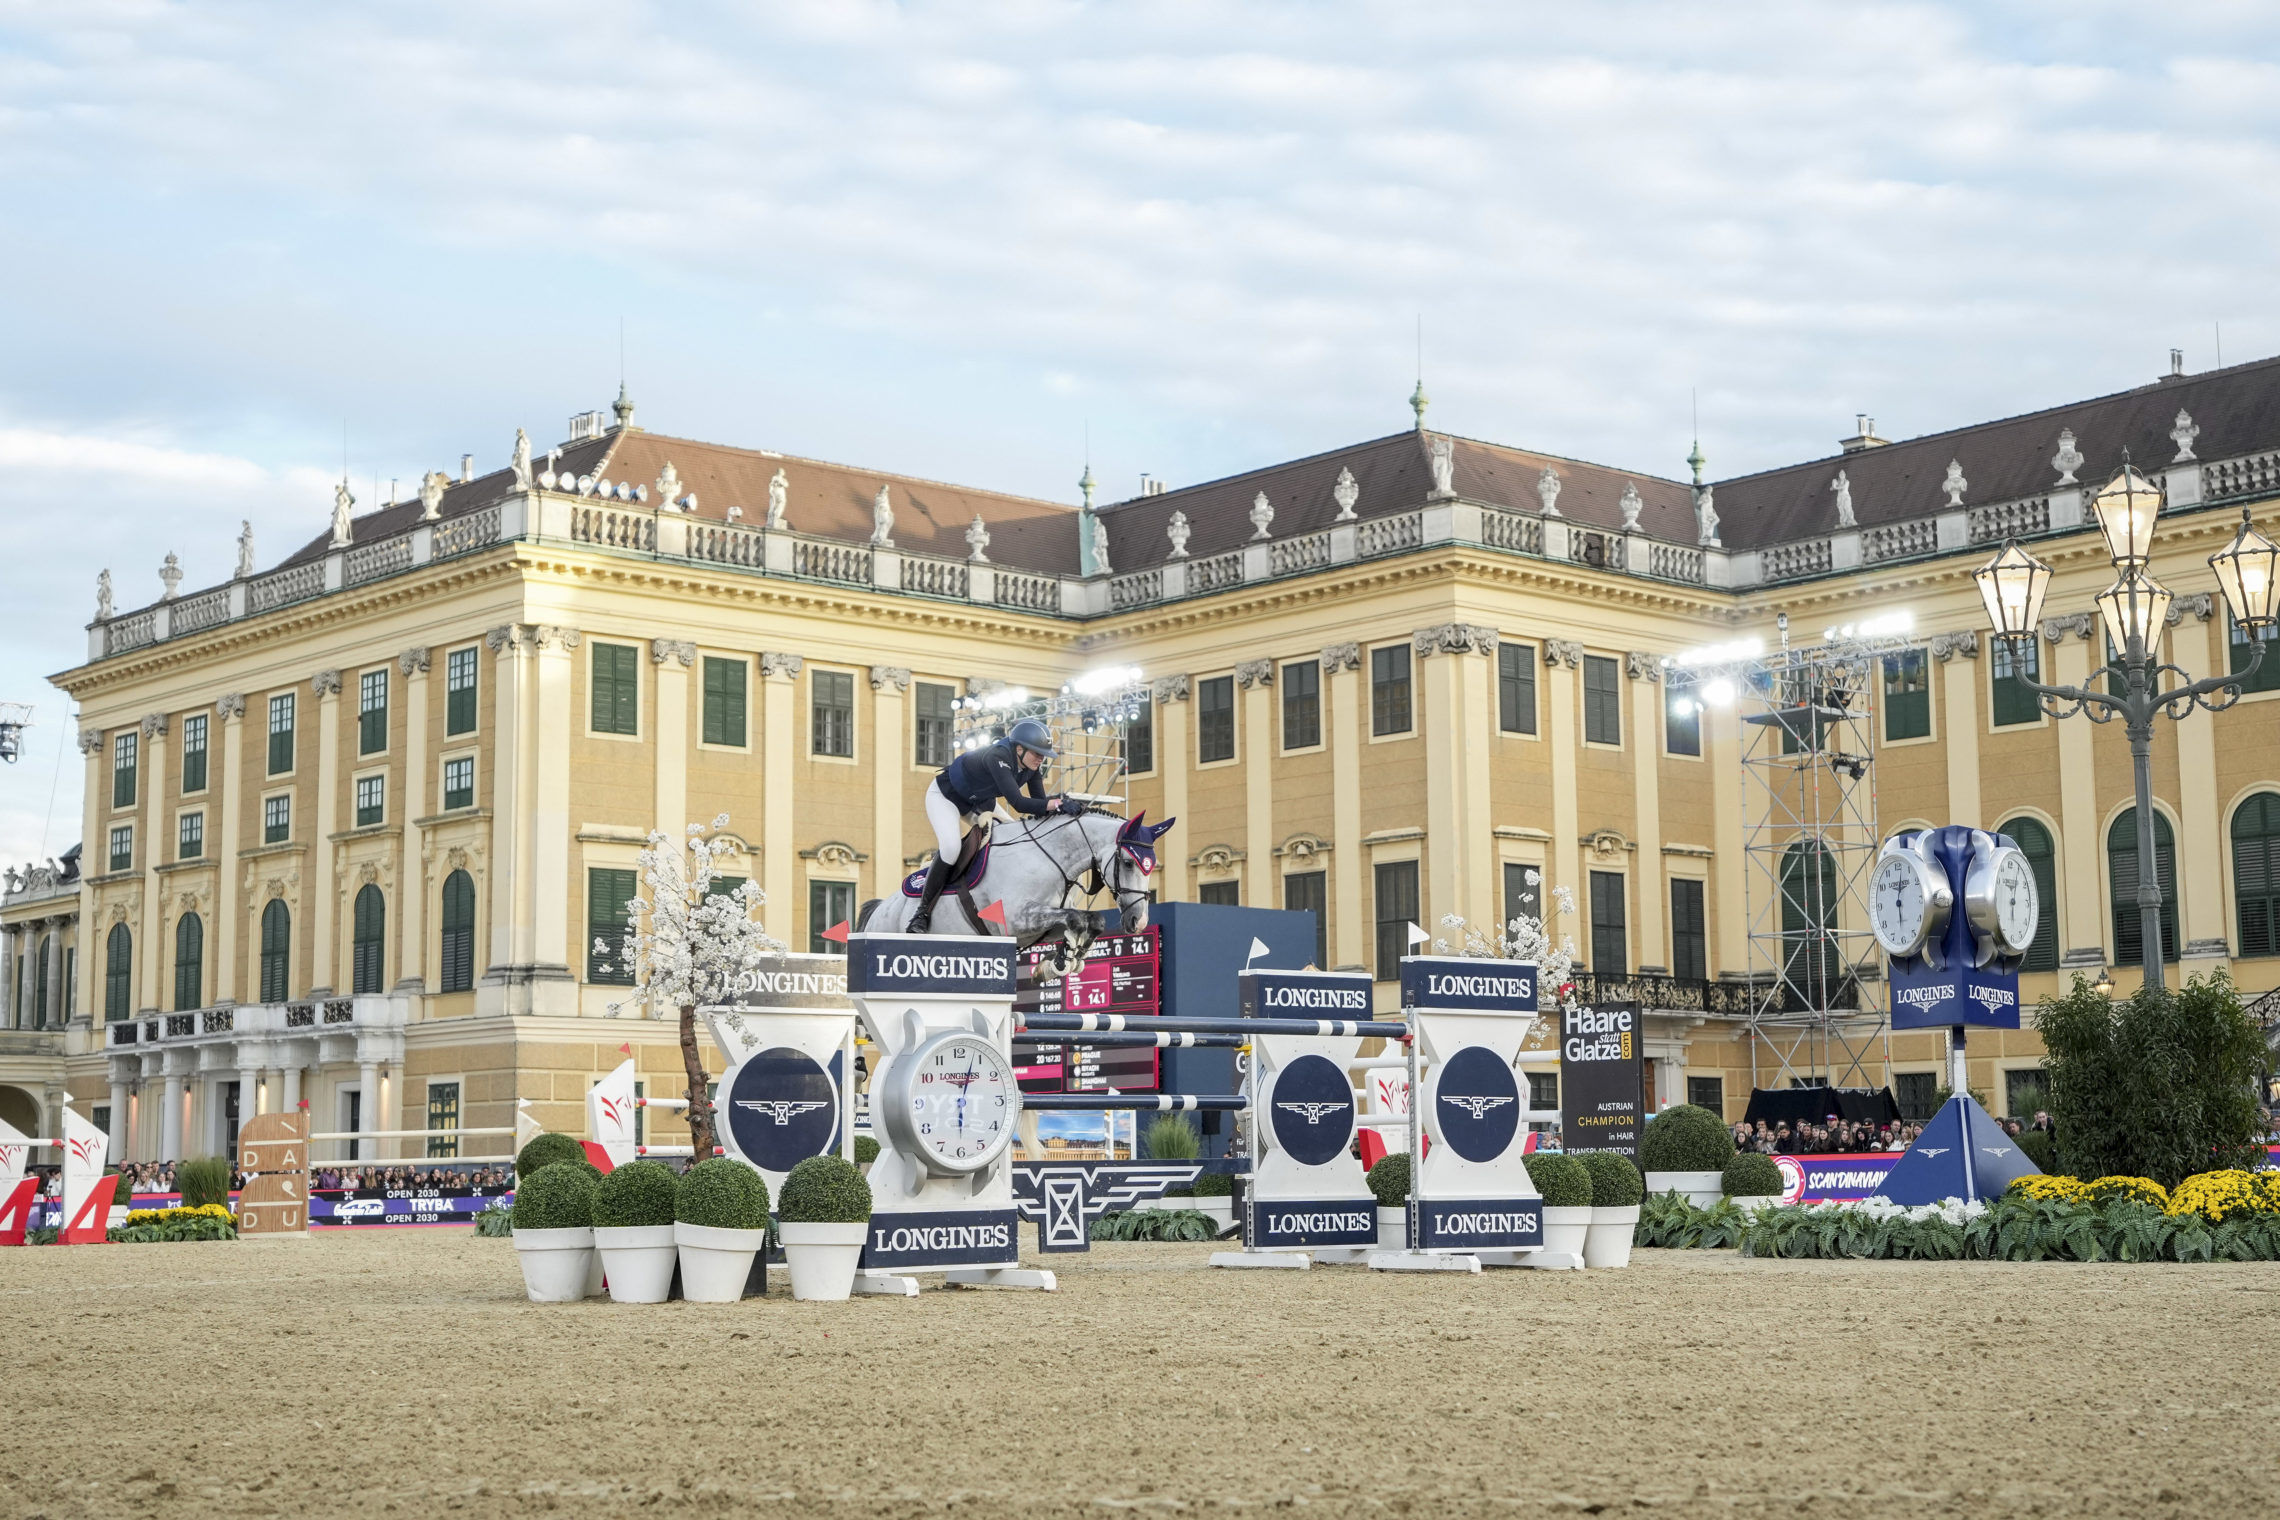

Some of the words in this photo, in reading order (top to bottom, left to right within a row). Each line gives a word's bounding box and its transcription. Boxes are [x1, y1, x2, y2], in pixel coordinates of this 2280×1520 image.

[1115, 944, 1122, 956] 0
[1131, 942, 1149, 954] 14.1
[876, 954, 1009, 980] LONGINES
[1428, 974, 1531, 998] LONGINES
[1073, 994, 1080, 1006] 0
[1088, 992, 1105, 1005] 14.1
[1265, 988, 1366, 1009] LONGINES
[1897, 984, 1955, 1004] LONGINES
[1969, 984, 2014, 1005] LONGINES
[1566, 1008, 1632, 1034] Haare
[1599, 1032, 1620, 1044] statt
[953, 1048, 966, 1058] 12
[1566, 1038, 1621, 1062] Glatze
[936, 1056, 943, 1065] 11
[921, 1073, 933, 1084] 10
[940, 1072, 980, 1081] LONGINES
[990, 1071, 998, 1081] 2
[915, 1098, 924, 1110] 9
[995, 1096, 1004, 1106] 3
[1598, 1102, 1633, 1111] AUSTRIAN
[988, 1121, 999, 1131] 4
[1578, 1116, 1634, 1126] CHAMPION
[921, 1123, 931, 1134] 8
[1609, 1132, 1615, 1141] in
[1617, 1132, 1634, 1140] HAIR
[937, 1141, 945, 1152] 7
[976, 1140, 985, 1150] 5
[956, 1147, 966, 1158] 6
[387, 1190, 413, 1198] OPEN
[417, 1189, 440, 1197] 2030
[409, 1198, 454, 1212] TRYBA
[385, 1214, 412, 1223] OPEN
[416, 1214, 438, 1222] 2030
[1268, 1212, 1371, 1234] LONGINES
[1434, 1212, 1537, 1235] LONGINES
[875, 1224, 1009, 1251] LONGINES
